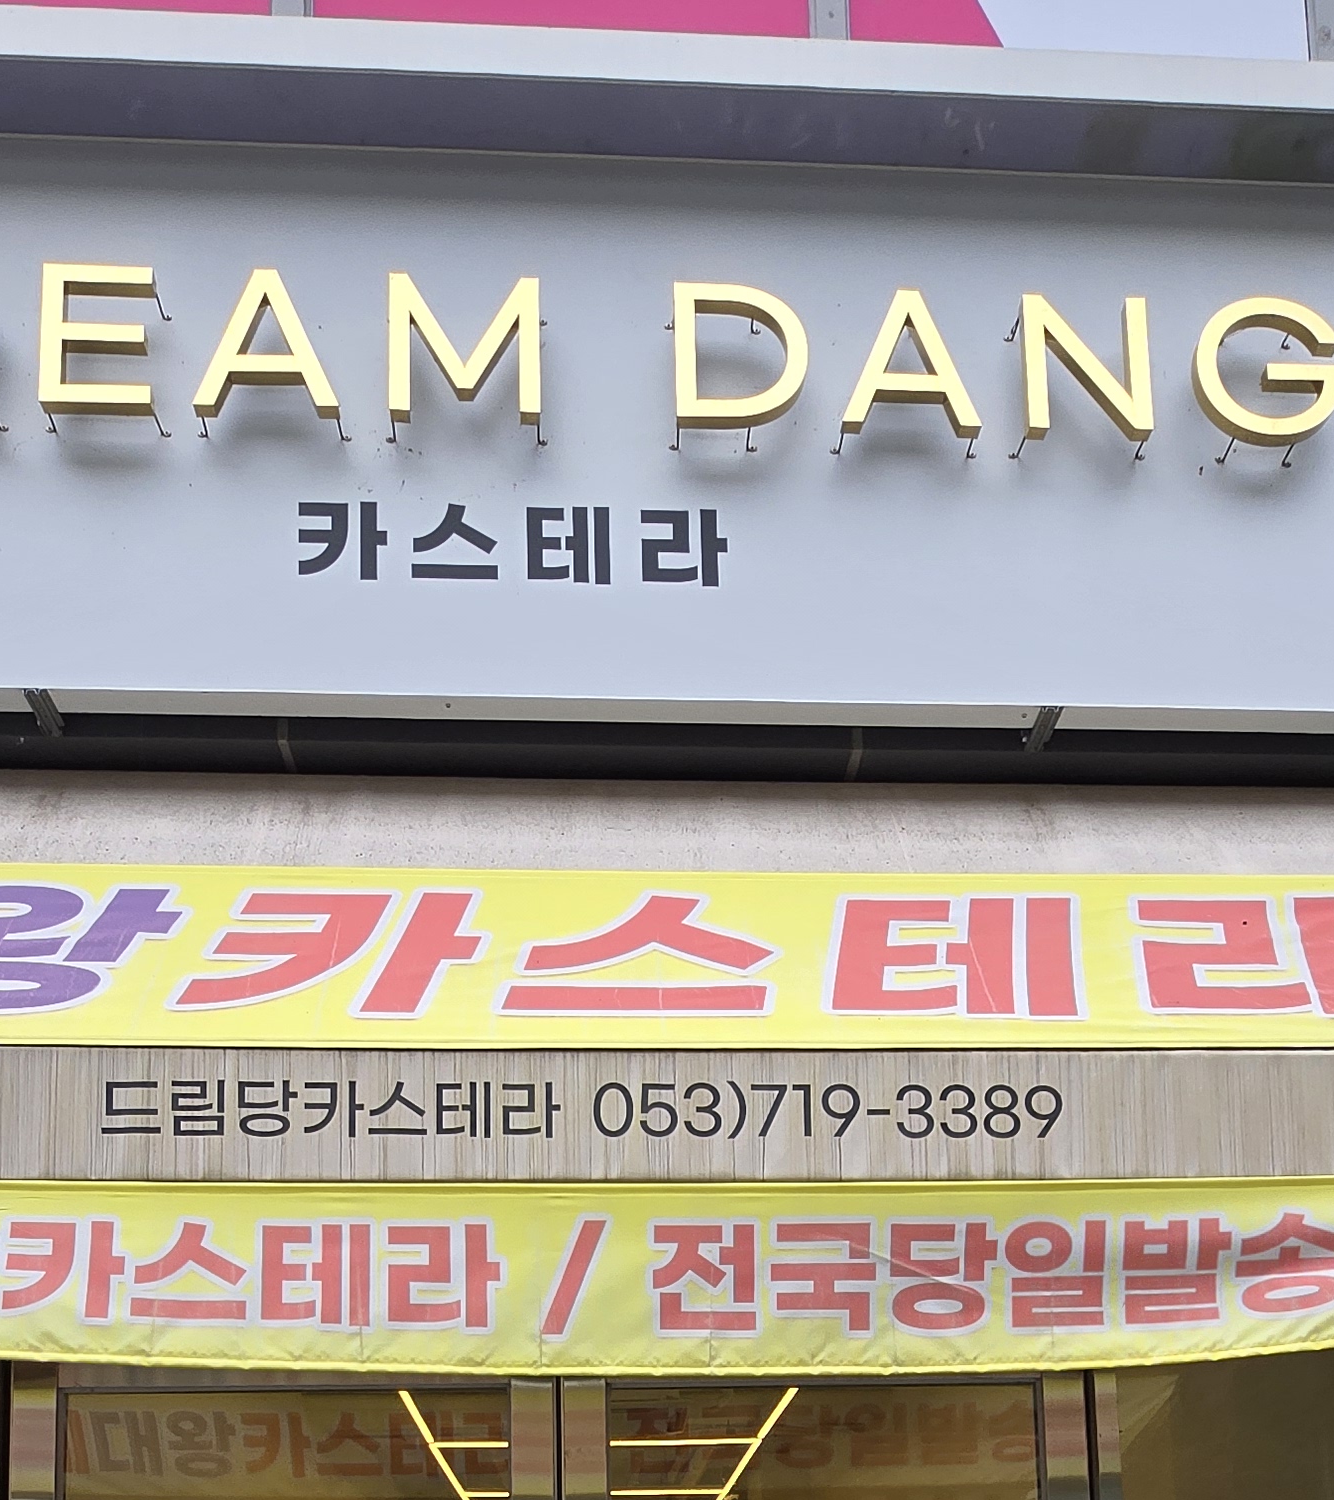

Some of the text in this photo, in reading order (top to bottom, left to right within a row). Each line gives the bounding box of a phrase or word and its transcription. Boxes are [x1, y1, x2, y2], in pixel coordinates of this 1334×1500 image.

[296, 501, 730, 588] 카스테라
[99, 1079, 1064, 1142] 드림당카스테라 053)719-3389
[542, 1219, 606, 1336] /
